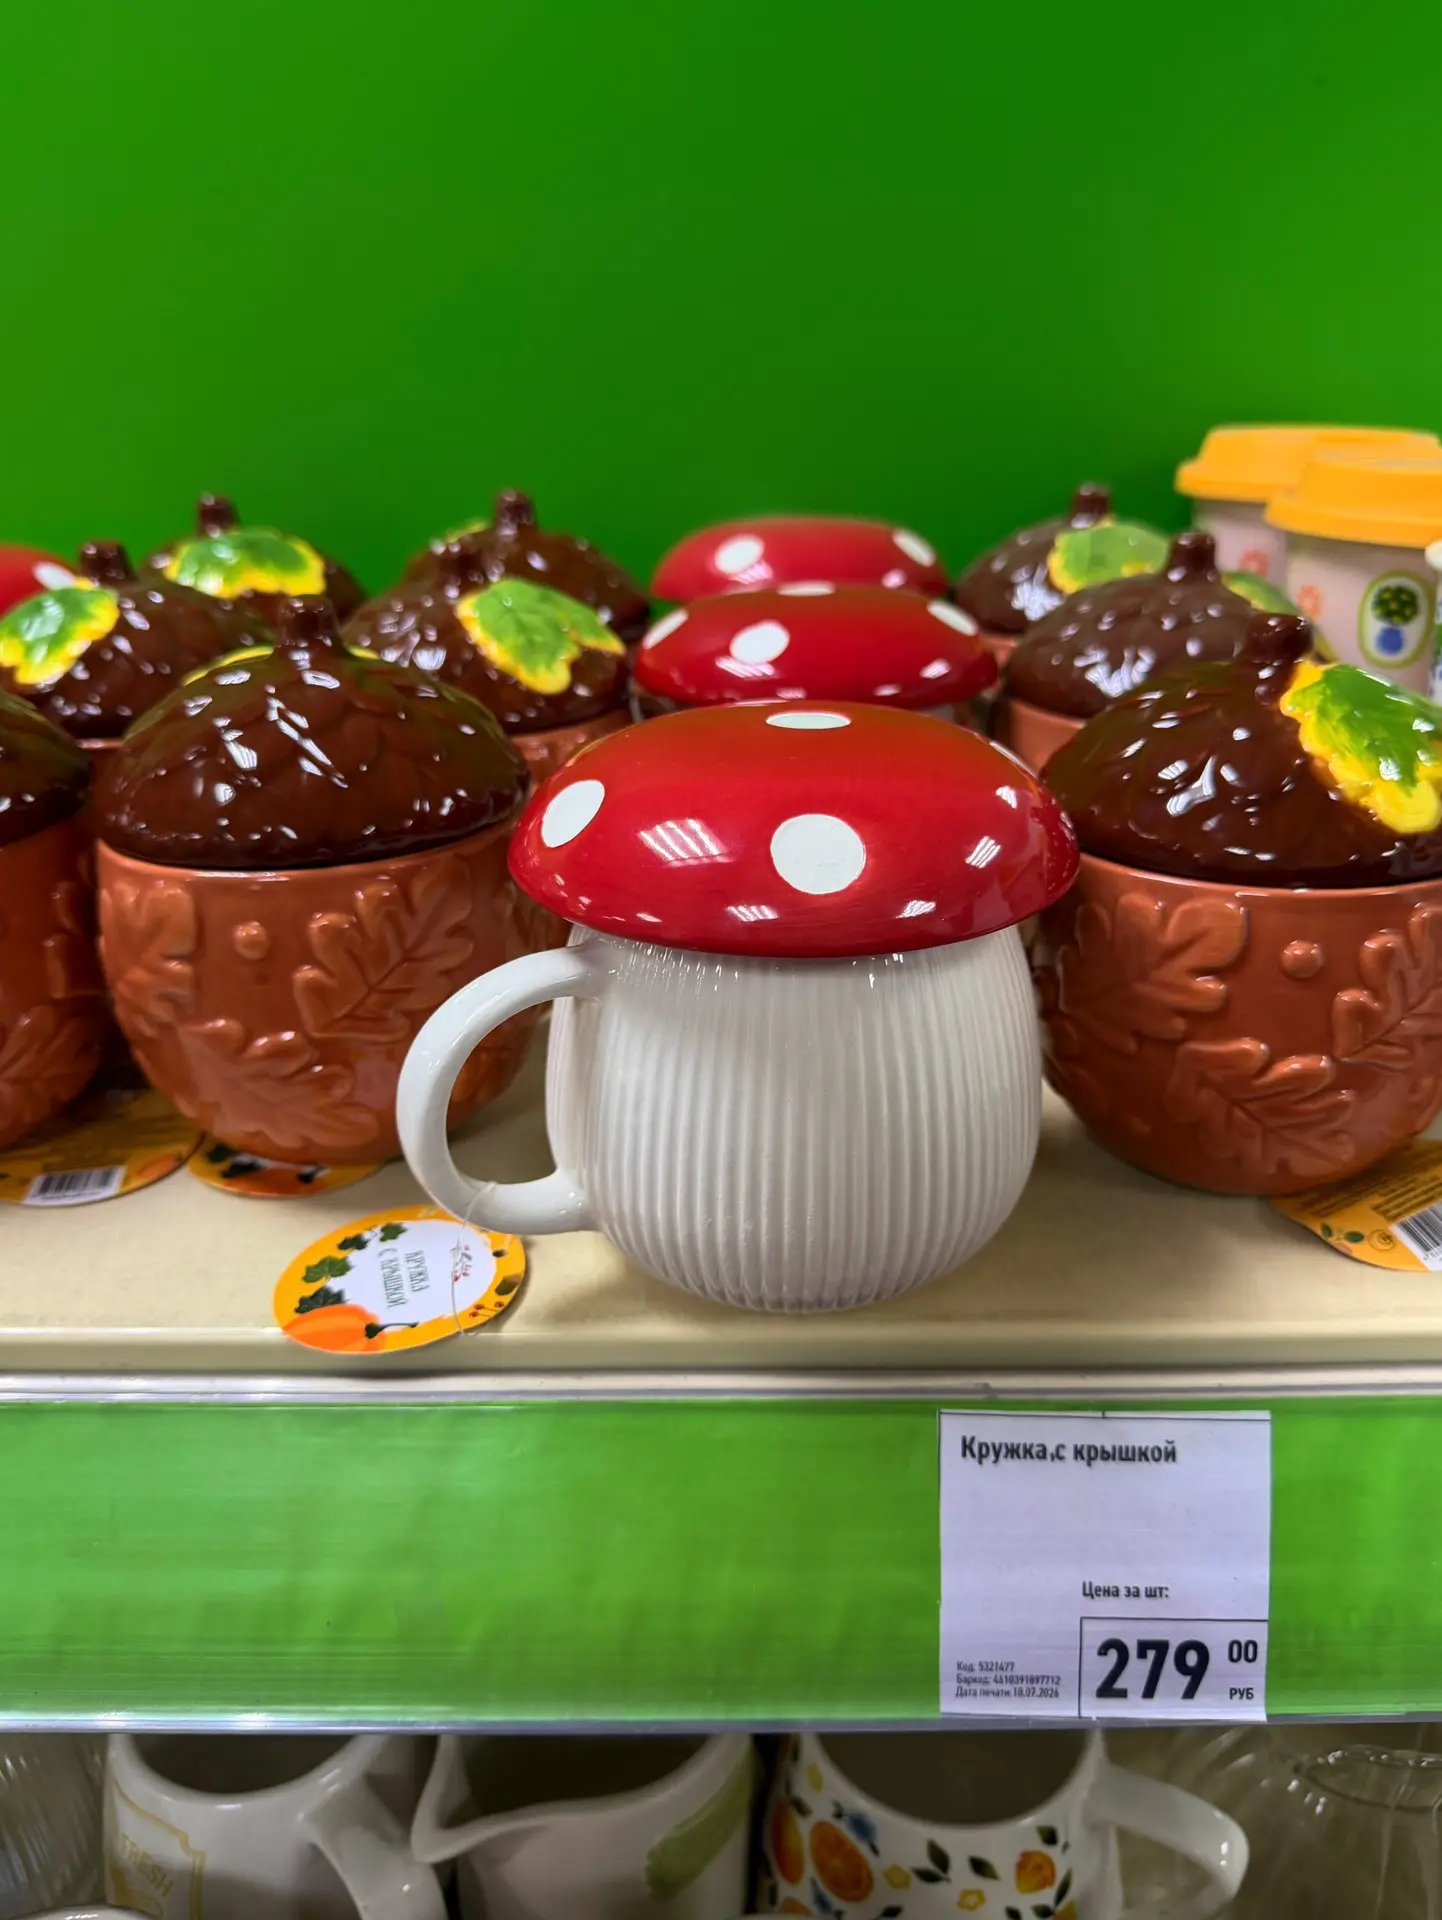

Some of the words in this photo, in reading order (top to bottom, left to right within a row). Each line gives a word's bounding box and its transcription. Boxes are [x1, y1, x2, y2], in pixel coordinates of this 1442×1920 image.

[405, 1250, 430, 1292] КРУЖКА
[1073, 1439, 1177, 1466] крышкой
[1082, 1581, 1120, 1599] Цена
[1124, 1585, 1140, 1598] за
[1145, 1586, 1169, 1598] шт:
[1095, 1638, 1210, 1699] 279
[1228, 1639, 1258, 1663] 00
[955, 1686, 977, 1698] Дата
[1013, 1687, 1060, 1698] 18.07.2026
[1229, 1687, 1254, 1700] РУБ
